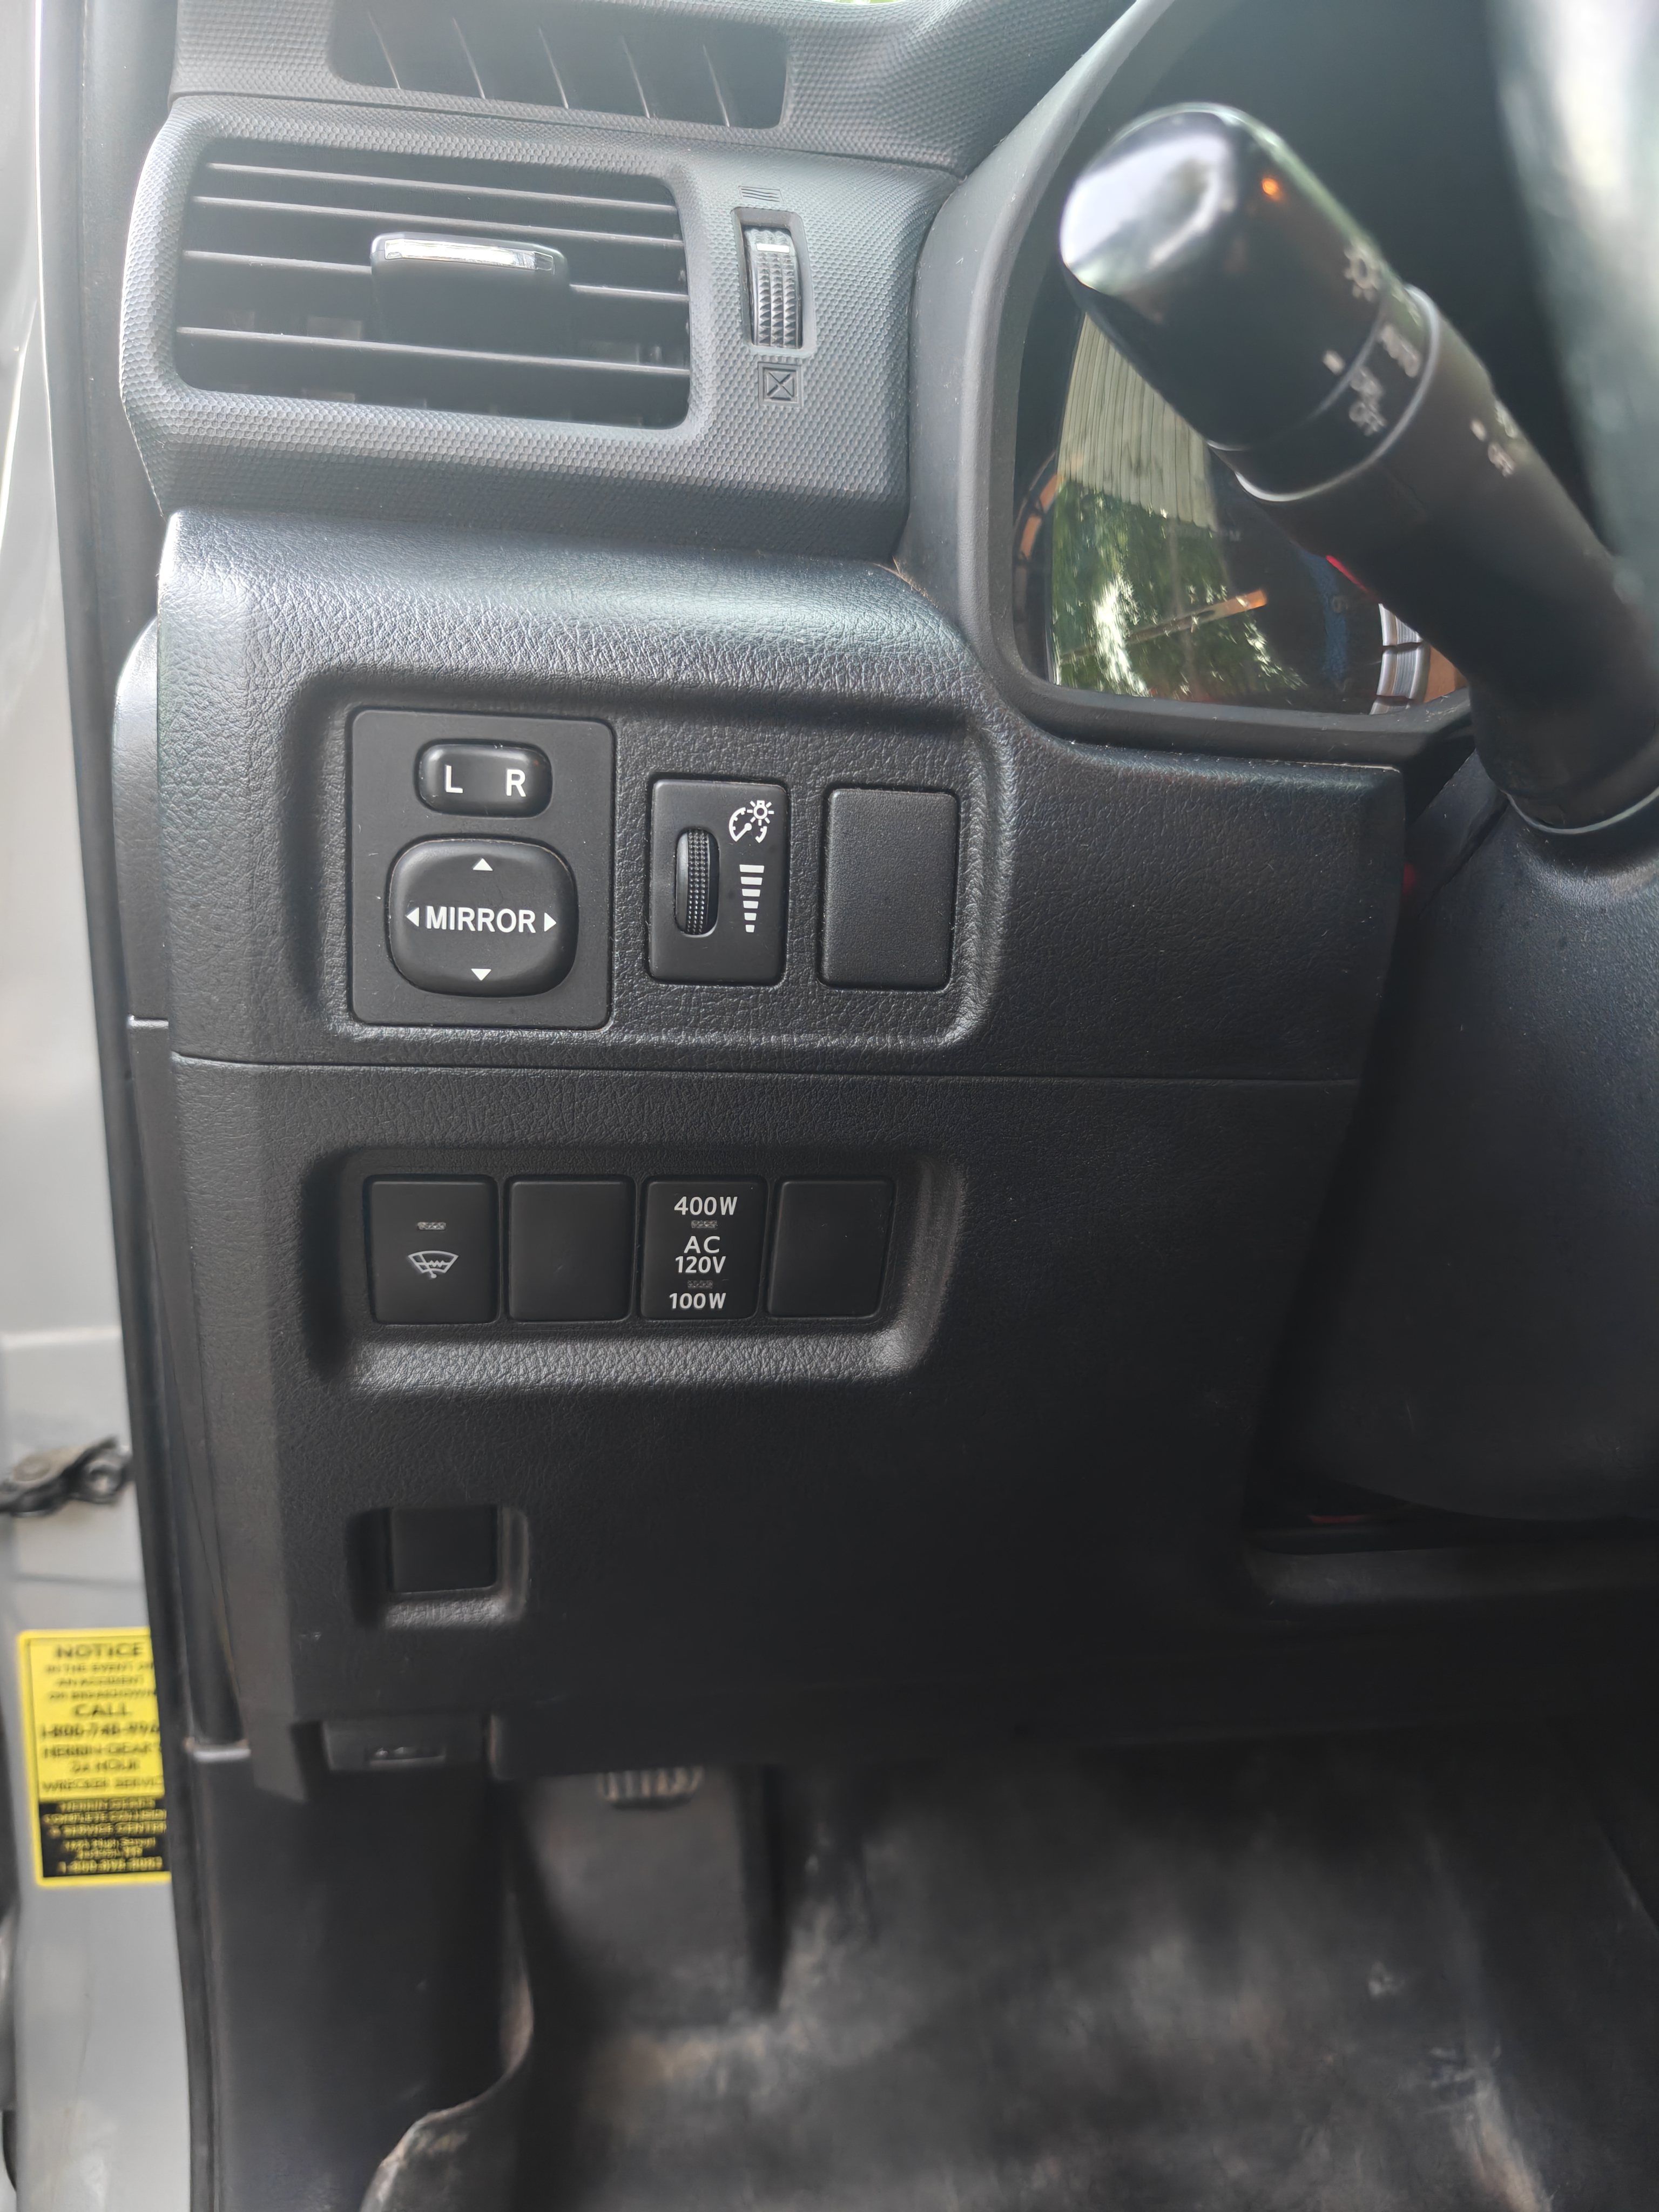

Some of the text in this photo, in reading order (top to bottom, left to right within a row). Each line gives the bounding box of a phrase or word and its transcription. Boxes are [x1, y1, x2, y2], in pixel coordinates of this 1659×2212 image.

[444, 764, 527, 798] L R
[425, 905, 536, 934] MIRROR
[674, 1196, 738, 1216] 400W
[683, 1235, 720, 1253] AC
[675, 1255, 726, 1273] 120V
[669, 1292, 726, 1309] 100W
[55, 1642, 145, 1657] NOTICE
[73, 1702, 132, 1716] CALL
